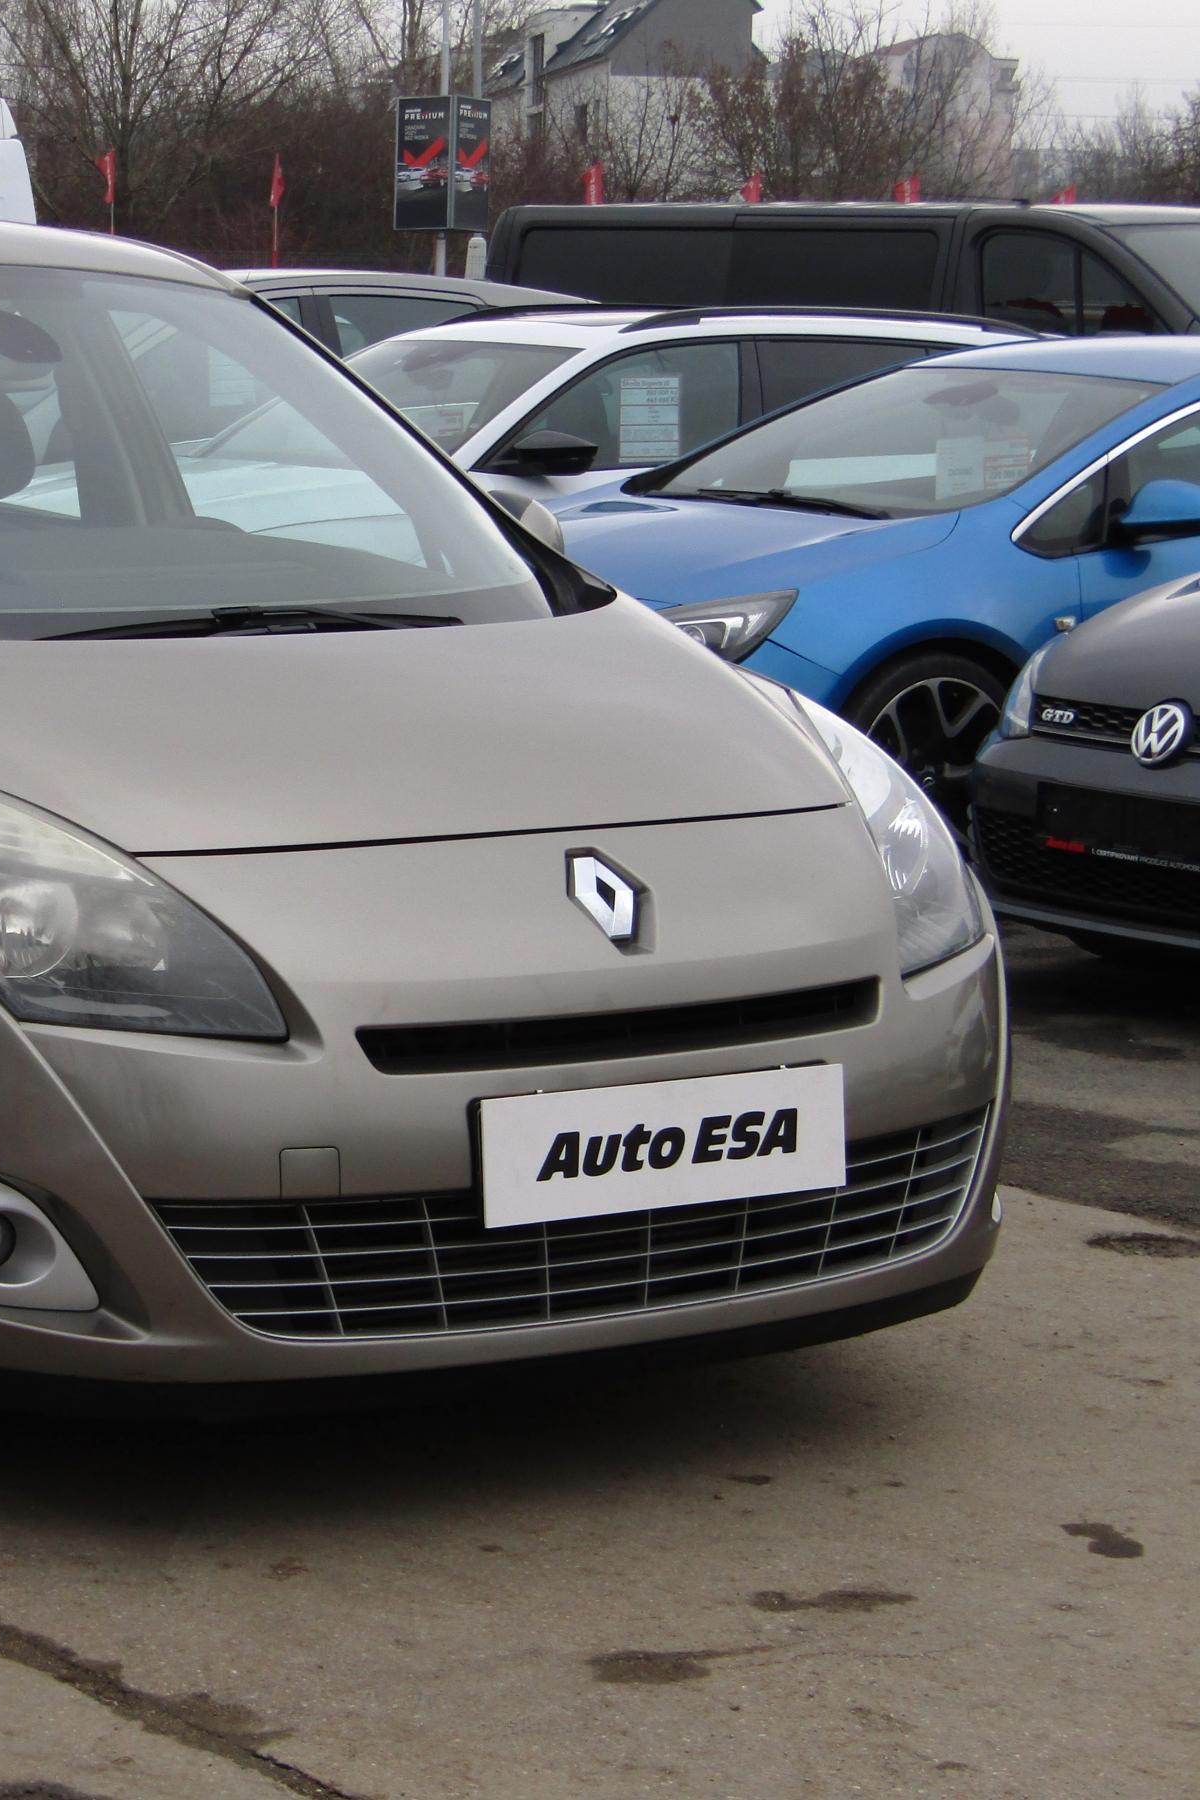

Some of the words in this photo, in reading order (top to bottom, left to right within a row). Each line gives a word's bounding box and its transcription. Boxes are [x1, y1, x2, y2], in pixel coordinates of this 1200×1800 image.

[1041, 708, 1075, 724] GTD
[536, 1123, 686, 1182] Auto
[691, 1108, 798, 1164] ESA
